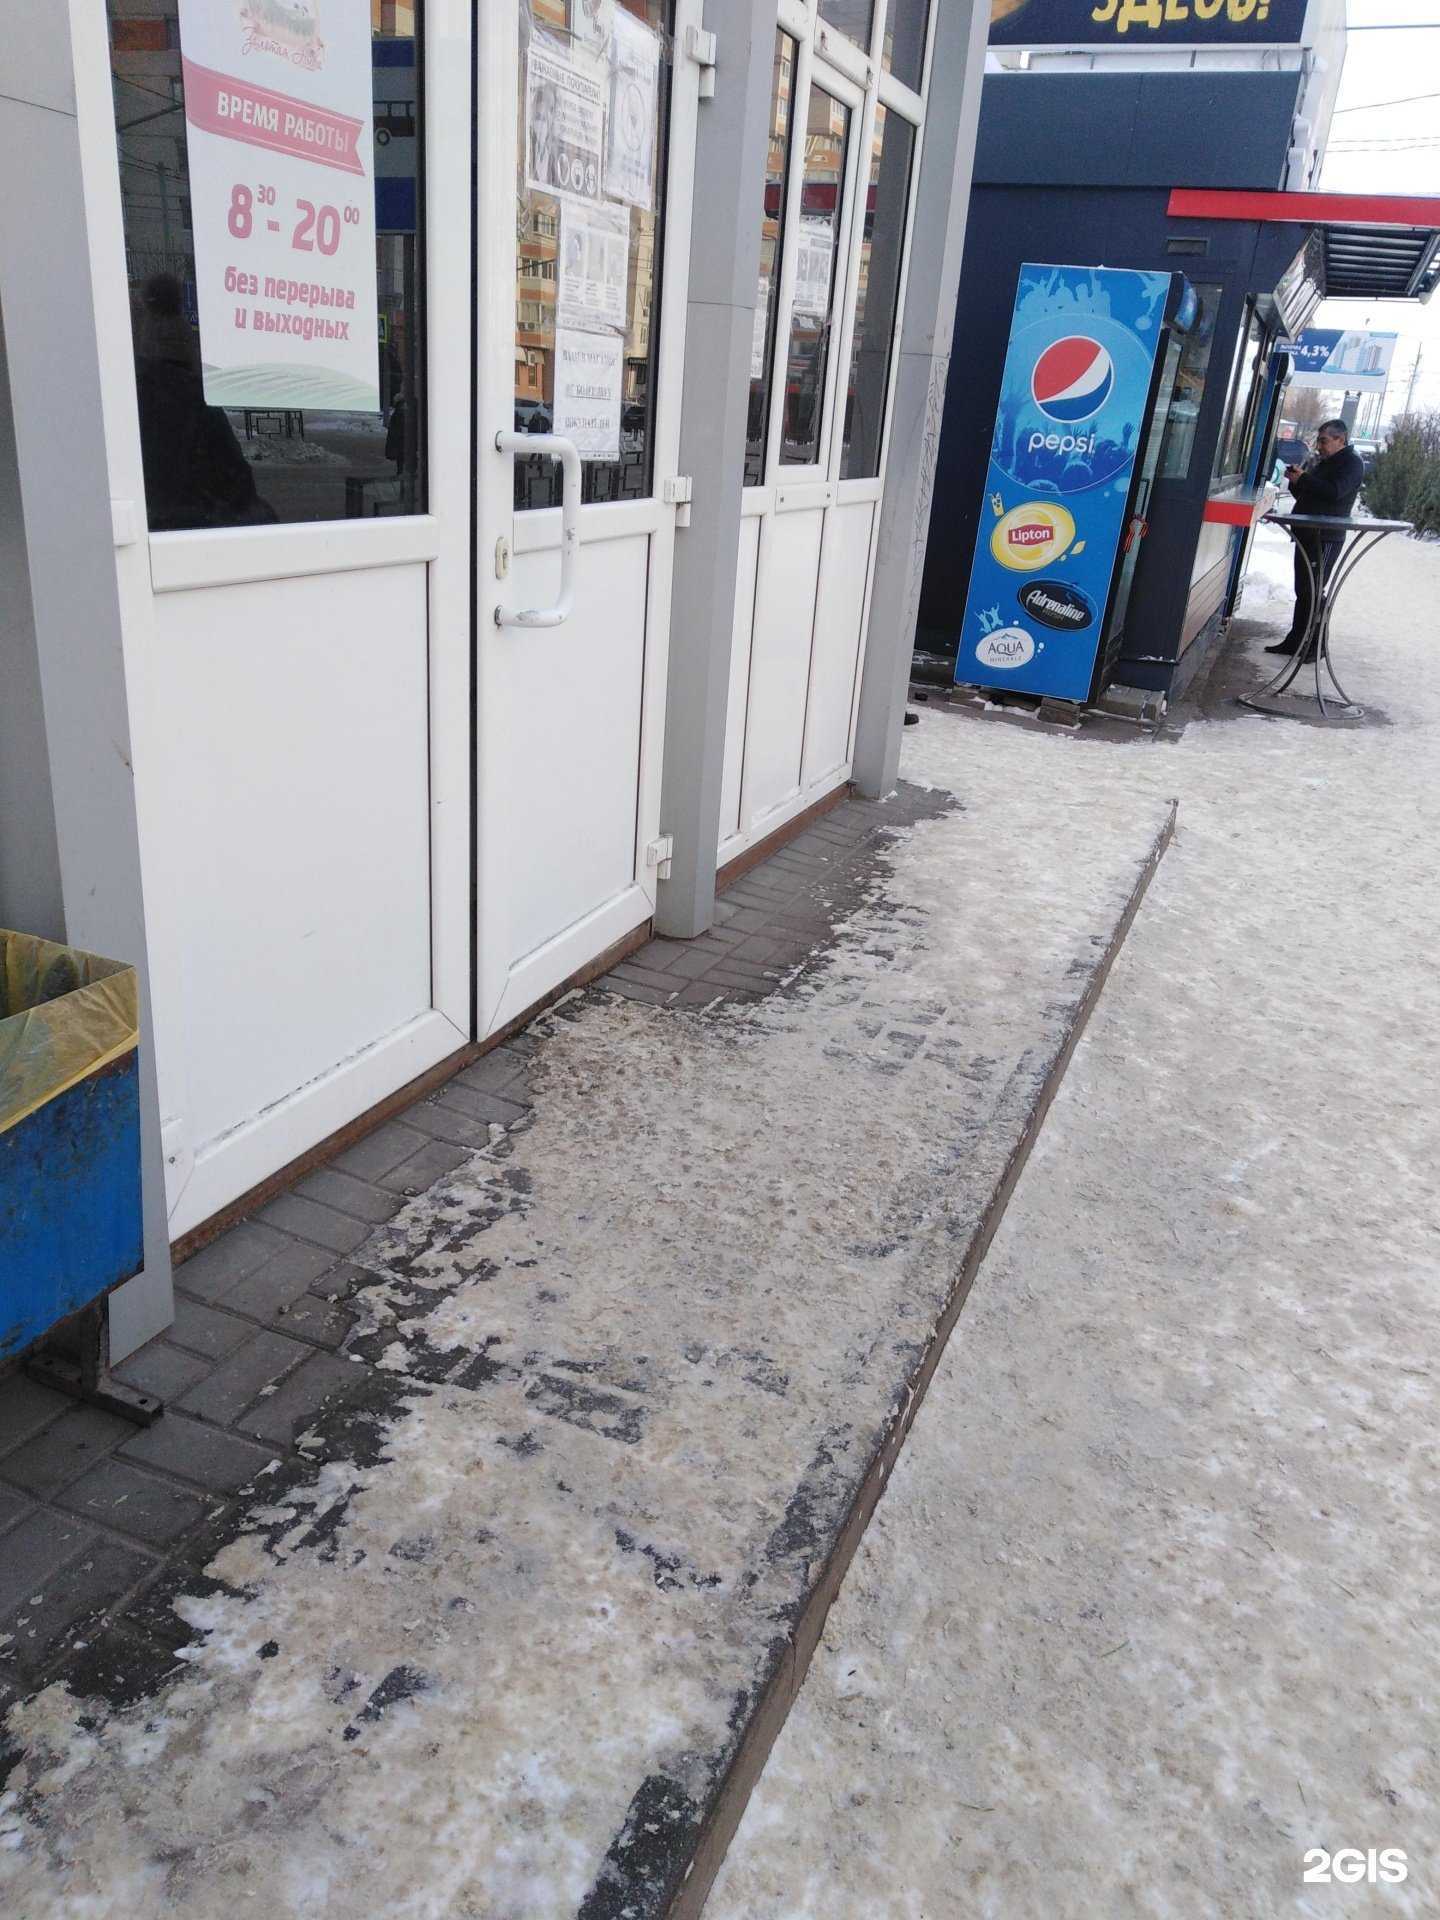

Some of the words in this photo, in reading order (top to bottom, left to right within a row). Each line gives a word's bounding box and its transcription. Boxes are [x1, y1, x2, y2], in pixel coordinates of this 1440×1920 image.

[217, 91, 279, 132] ВРЕМЯ
[284, 112, 349, 152] РАБОТЫ
[224, 266, 258, 295] без
[264, 276, 355, 309] перерыва
[234, 308, 247, 328] и
[253, 310, 349, 340] выходных
[1028, 433, 1095, 455] pepsi
[1012, 529, 1050, 542] Lipton
[1026, 590, 1085, 622] Adrenaline
[988, 641, 1024, 655] AQUA
